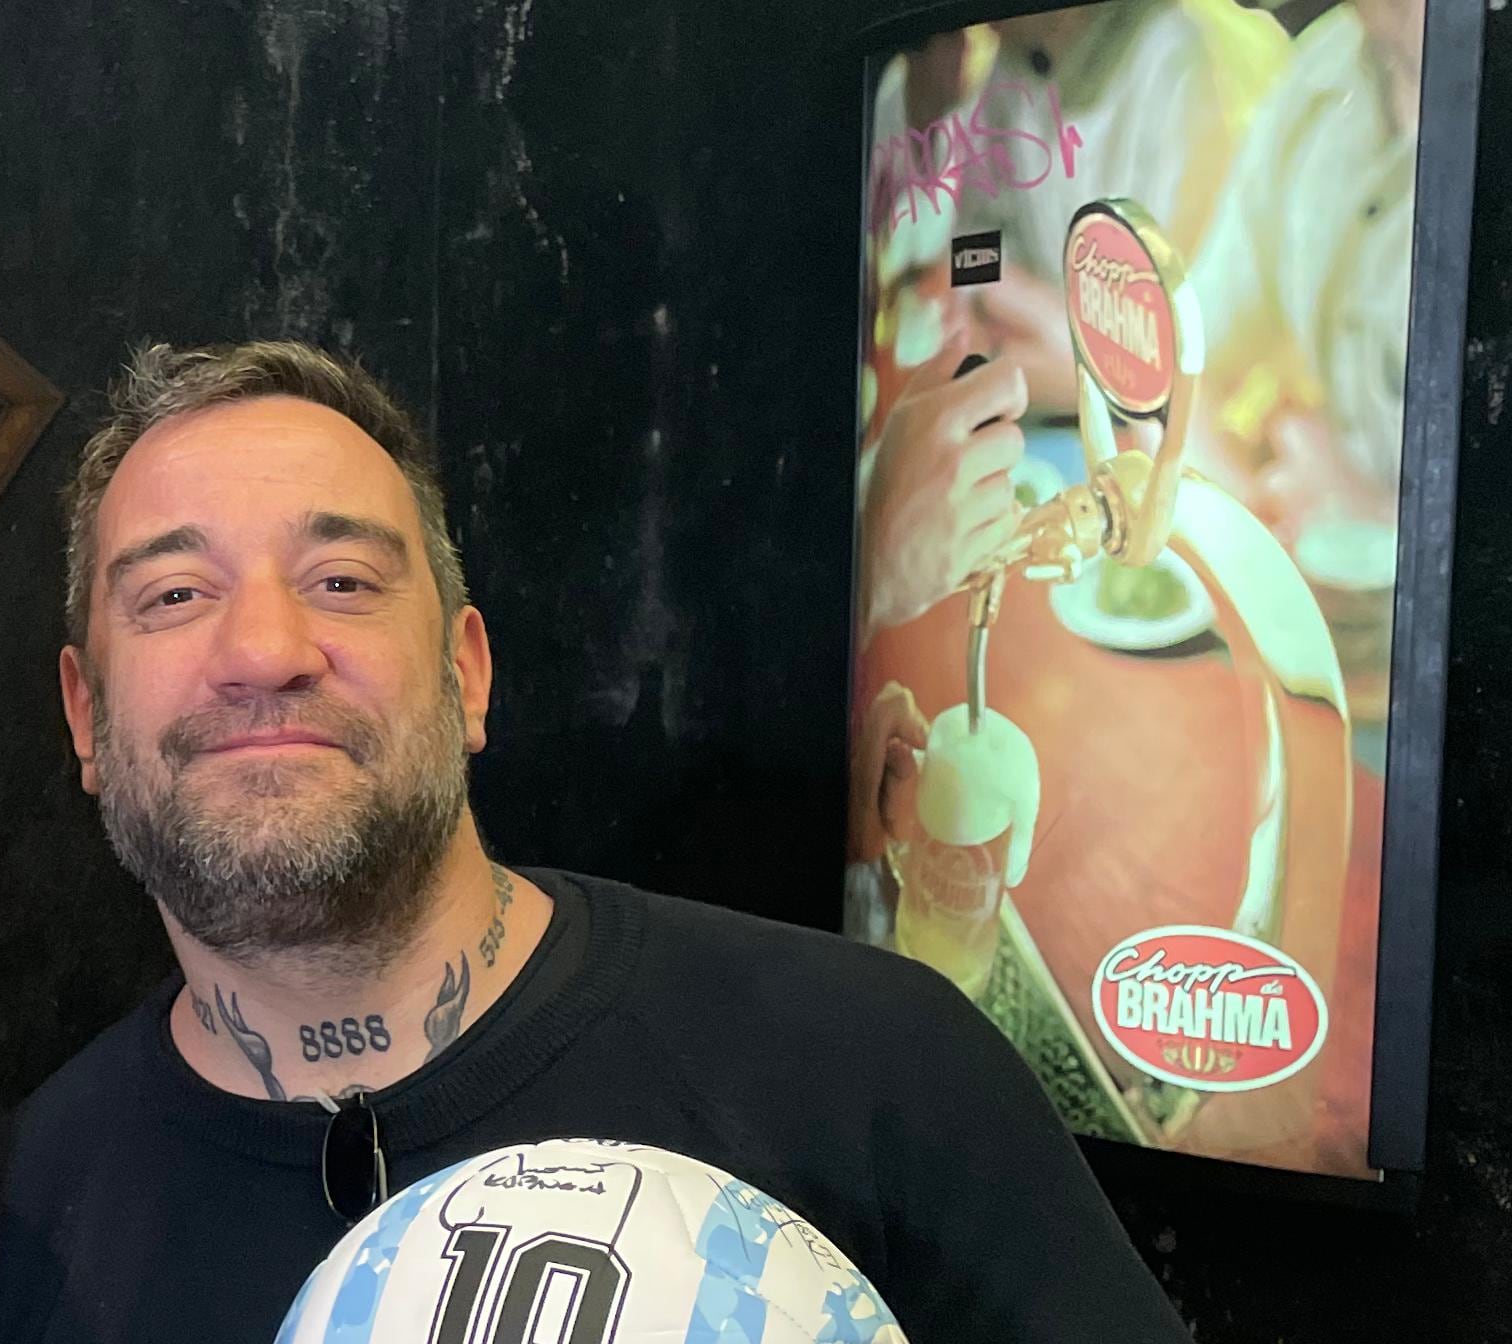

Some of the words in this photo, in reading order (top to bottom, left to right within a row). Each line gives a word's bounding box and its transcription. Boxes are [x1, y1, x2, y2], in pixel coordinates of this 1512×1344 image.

[1071, 235, 1159, 295] Chopp
[1079, 271, 1161, 371] BRAHMA
[1103, 946, 1296, 994] Chopp
[299, 1014, 391, 1062] 8888
[1117, 981, 1292, 1050] BRAHMA
